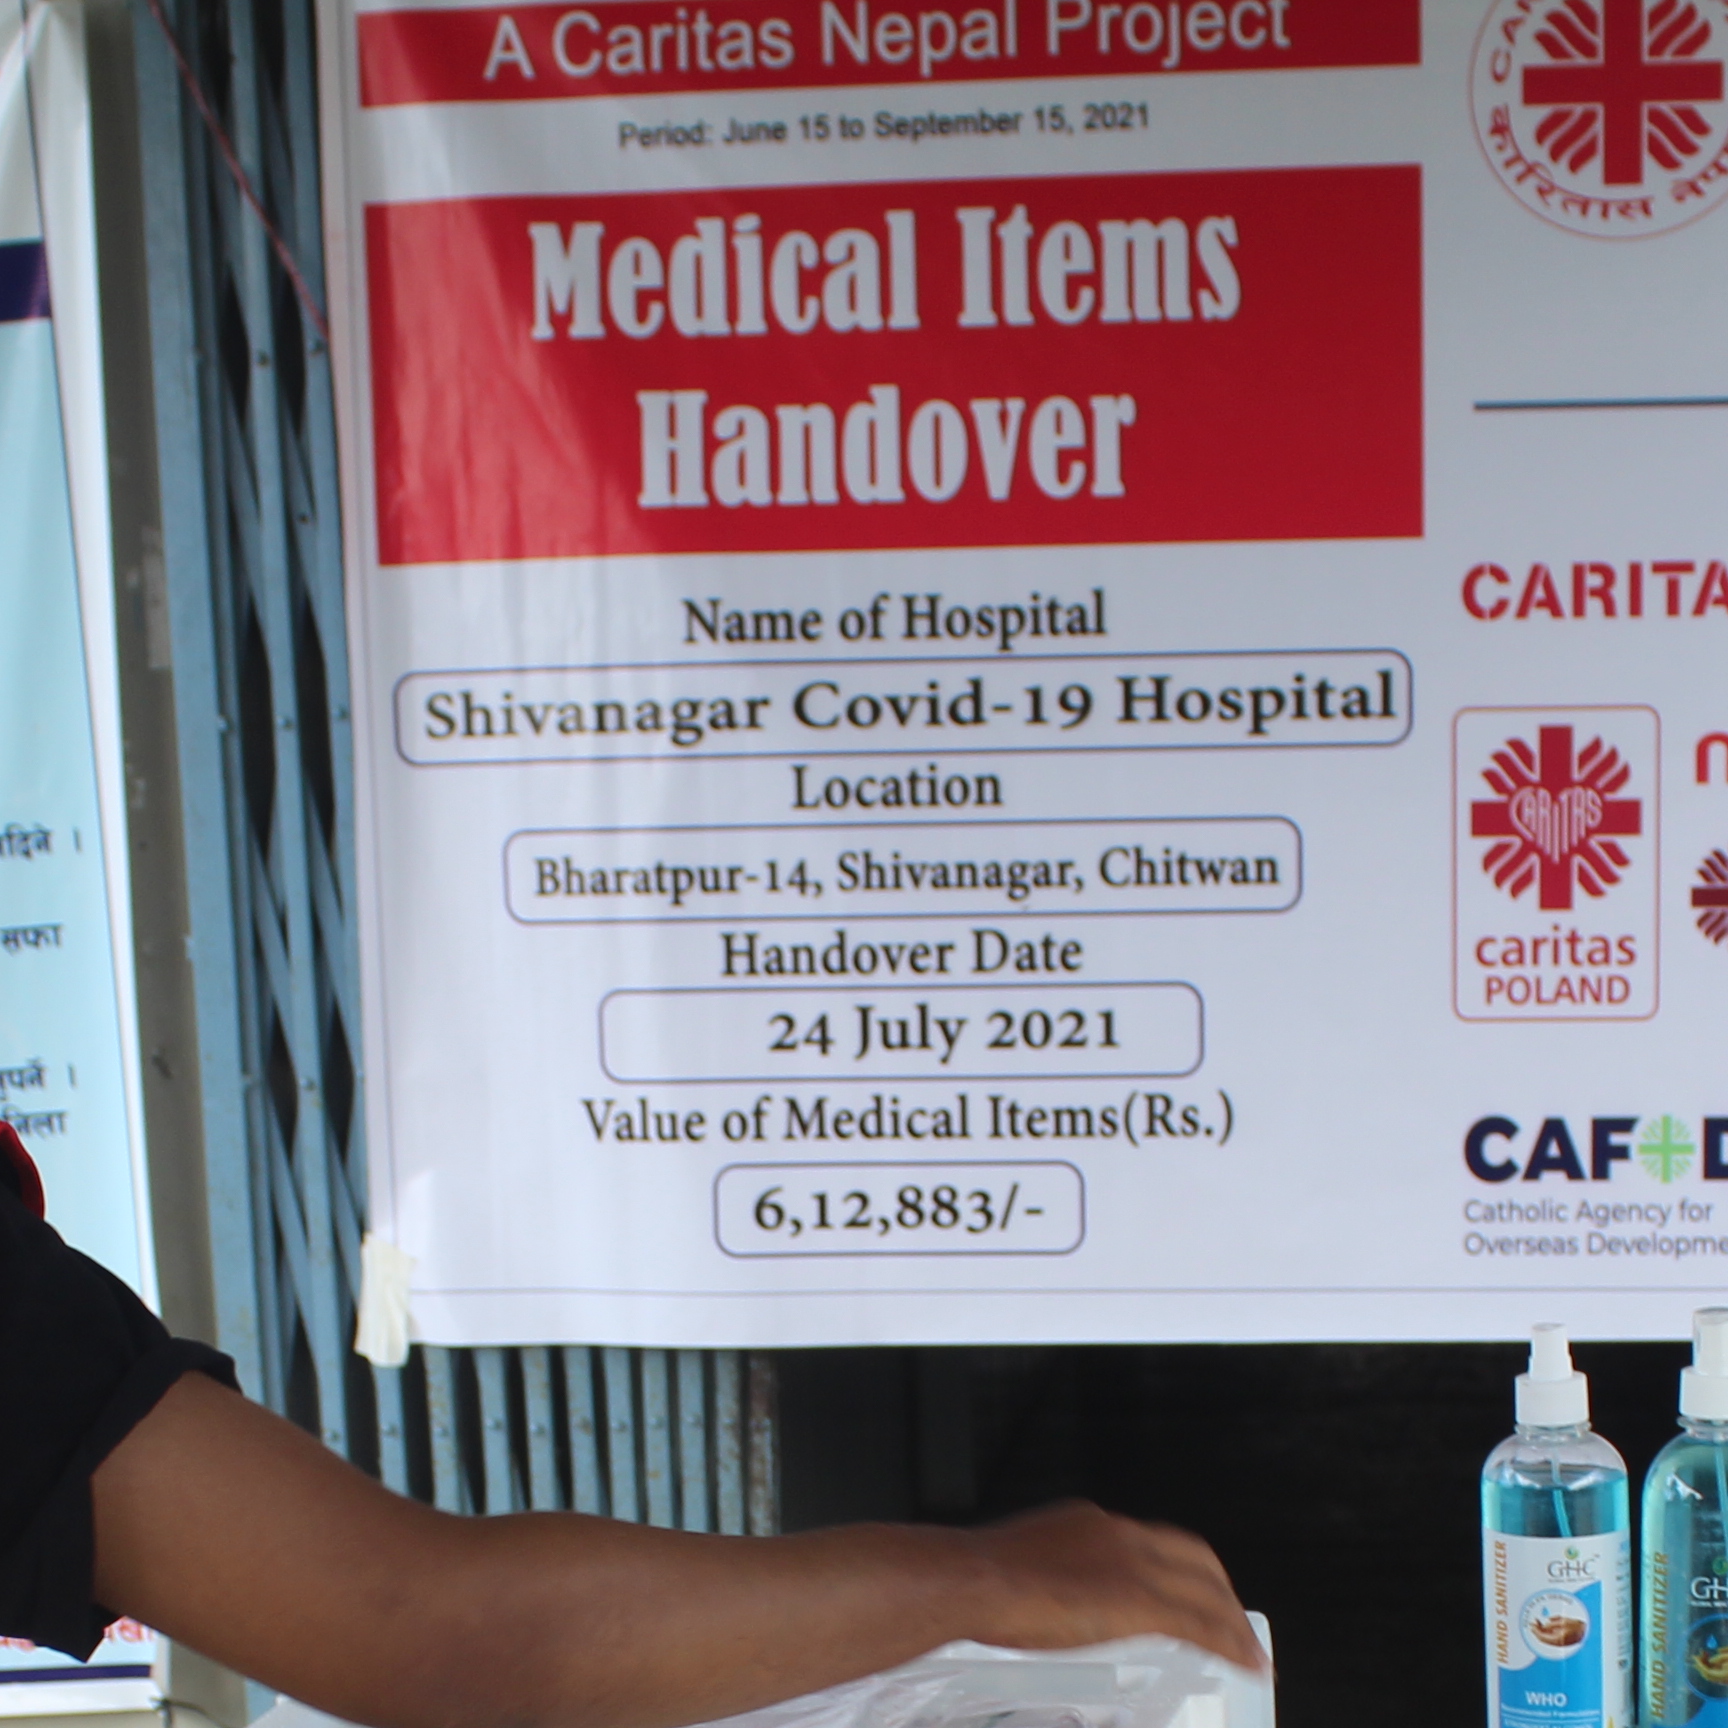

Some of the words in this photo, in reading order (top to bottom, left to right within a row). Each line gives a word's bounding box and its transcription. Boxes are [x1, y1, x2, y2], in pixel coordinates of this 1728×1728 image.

[484, 29, 534, 81] A
[552, 11, 795, 79] Caritas
[822, 0, 1017, 75] Nepal
[1048, 0, 1292, 68] Project
[619, 120, 712, 148] Period:
[723, 117, 787, 144] June
[800, 117, 830, 140] 15
[839, 117, 866, 140] to
[875, 109, 1021, 144] September
[1034, 107, 1073, 137] 15,
[1084, 104, 1149, 132] 2021
[530, 210, 919, 341] Medical
[957, 205, 1242, 325] Items
[636, 385, 1136, 509] Handover
[682, 601, 822, 645] Name
[839, 593, 889, 640] of
[900, 587, 1107, 653] Hospital
[424, 691, 771, 747] Shivanagar
[791, 676, 1094, 732] Covid-19
[1115, 668, 1397, 737] Hospital
[791, 764, 1003, 810] Location
[534, 856, 823, 906] Bharatpur-14,
[836, 852, 1084, 903] Shivanagar,
[1098, 845, 1279, 890] Chitwan
[720, 932, 955, 978] Handover
[971, 929, 1083, 973] Date
[1476, 929, 1637, 970] caritas
[1484, 973, 1631, 1007] POLAND
[768, 1011, 835, 1055] 24
[853, 1004, 968, 1063] July
[986, 1008, 1121, 1050] 2021
[581, 1099, 707, 1143] Value
[721, 1096, 771, 1140] of
[783, 1094, 969, 1142] Medical
[987, 1088, 1235, 1146] Items(Rs.)
[752, 1182, 1045, 1237] 6,12,883/-
[1463, 1199, 1568, 1225] Catholic
[1575, 1200, 1668, 1230] Agency
[1677, 1197, 1714, 1223] for
[1463, 1232, 1578, 1256] Overseas
[1494, 1540, 1508, 1616] SANITIZER
[1651, 1552, 1669, 1656] SANITIZER
[1496, 1617, 1509, 1664] HAND
[1525, 1692, 1567, 1707] WHO
[1651, 1660, 1669, 1719] HAND
